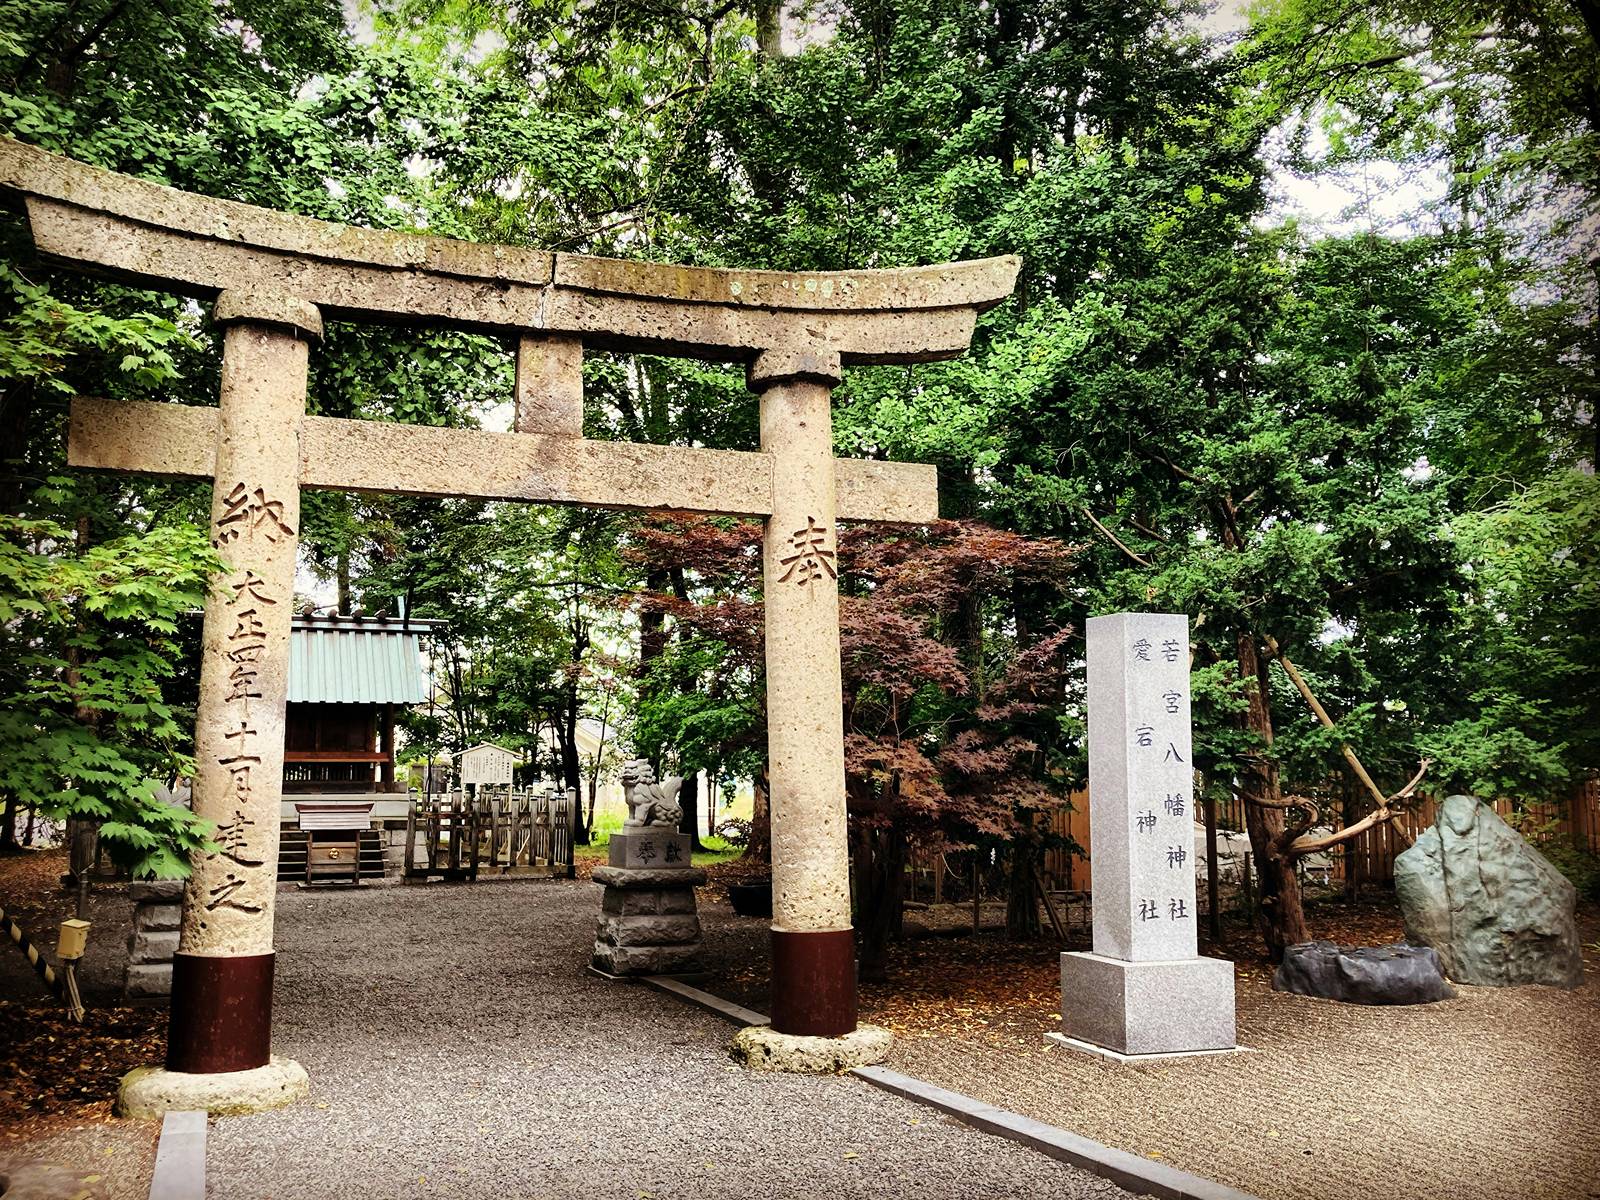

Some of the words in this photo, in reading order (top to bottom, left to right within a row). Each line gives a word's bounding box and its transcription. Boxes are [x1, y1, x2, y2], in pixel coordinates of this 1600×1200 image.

[213, 482, 294, 549] 納
[777, 515, 837, 596] 奉
[1132, 638, 1160, 922] 愛宕神社
[1161, 639, 1188, 921] 若宮八幡神社
